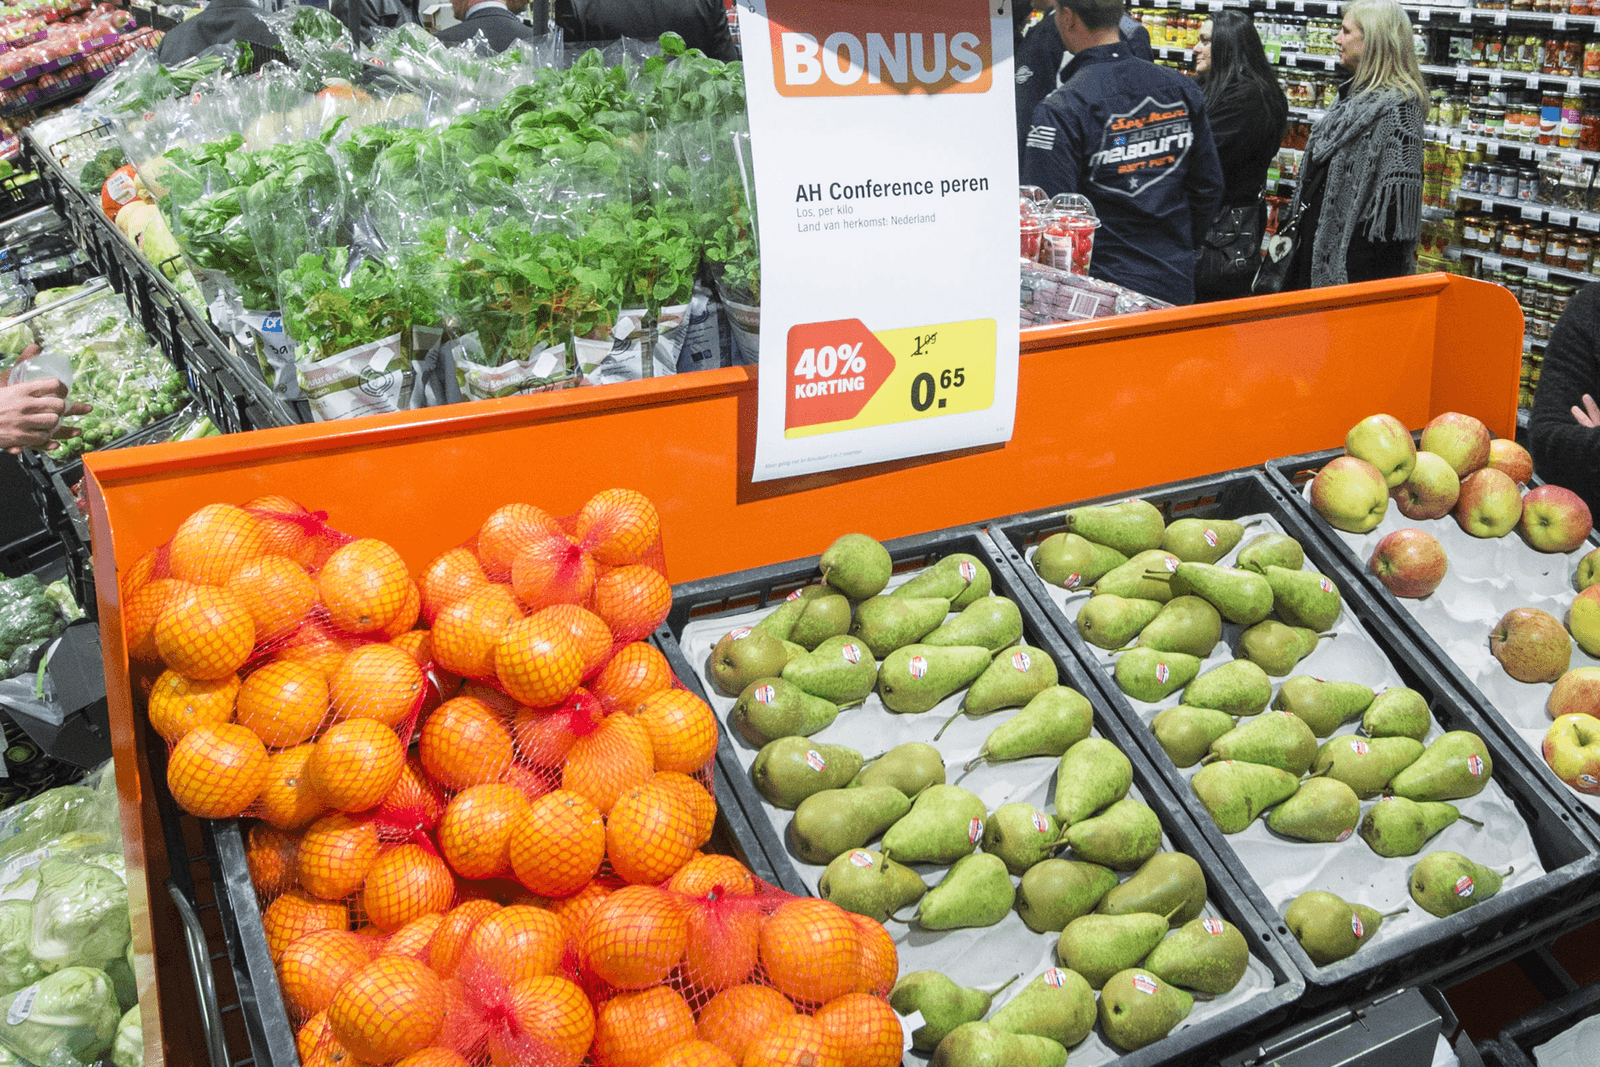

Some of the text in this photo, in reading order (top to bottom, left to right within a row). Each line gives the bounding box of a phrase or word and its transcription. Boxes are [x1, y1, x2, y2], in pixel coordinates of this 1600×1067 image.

[781, 31, 983, 86] BONUS
[1088, 132, 1194, 167] melbourn
[795, 177, 989, 203] AH Conference peren
[796, 204, 854, 219] Los, per kilo
[797, 213, 936, 233] Land van herkomst: Nederland
[794, 342, 867, 380] 40%
[795, 376, 865, 399] KORTING
[910, 367, 965, 412] 0.65
